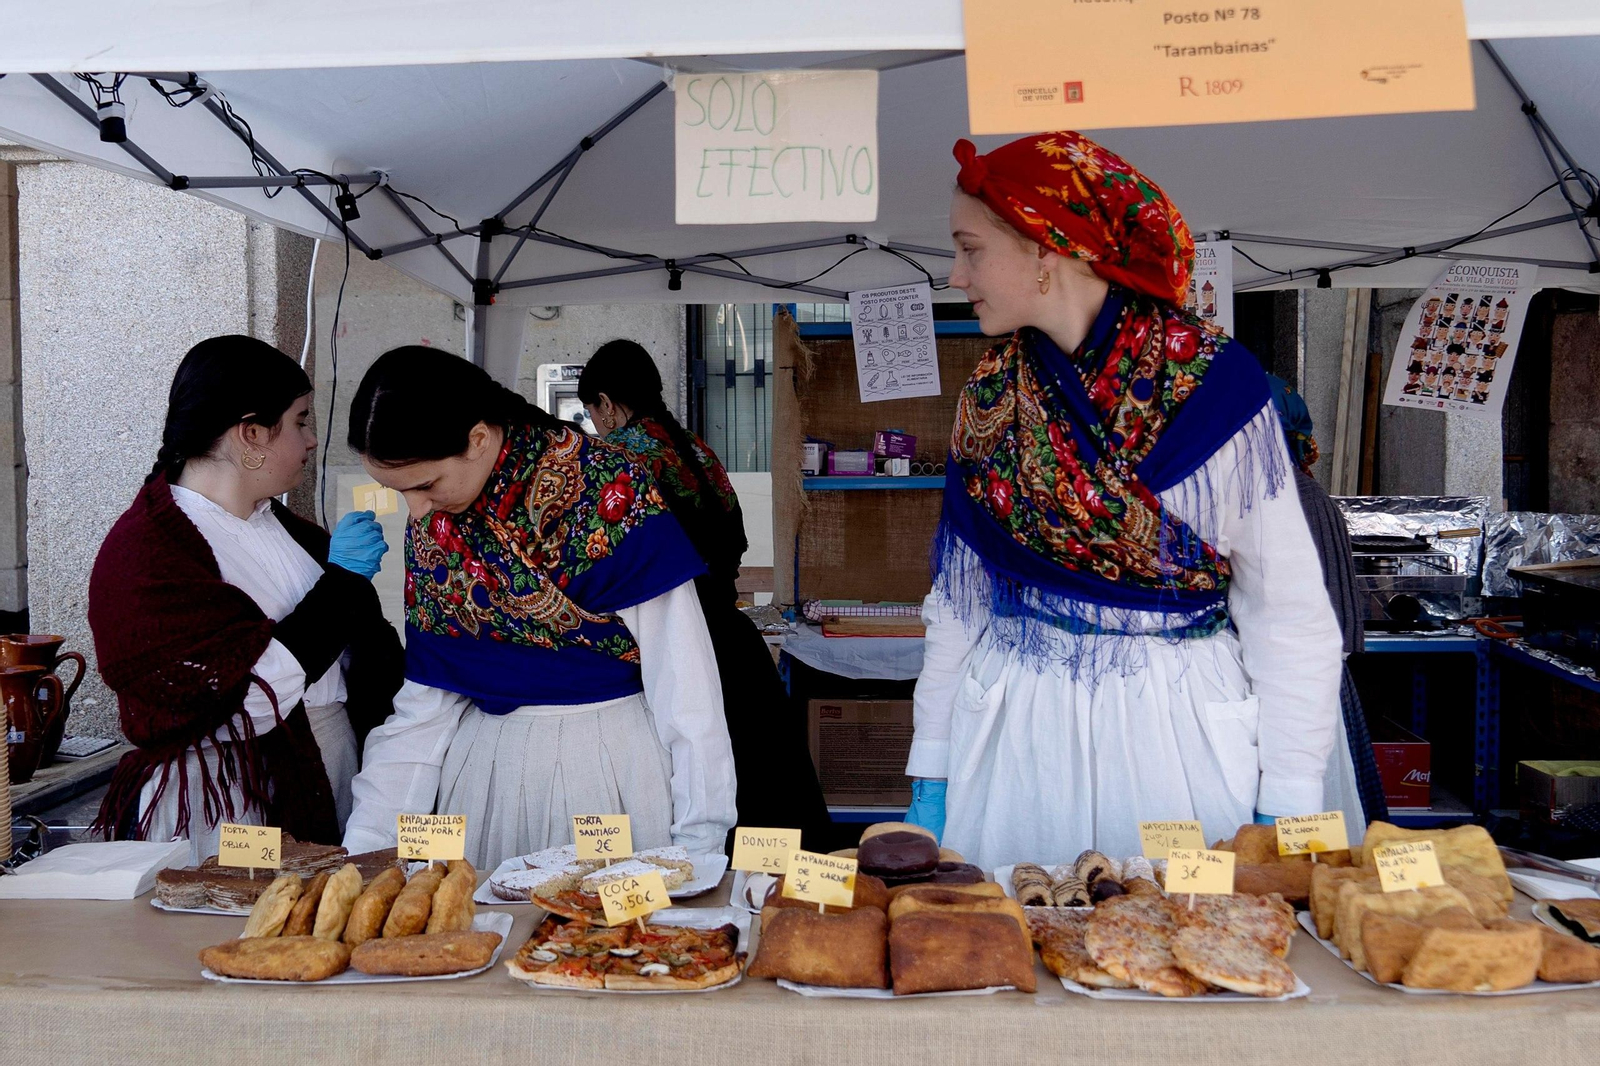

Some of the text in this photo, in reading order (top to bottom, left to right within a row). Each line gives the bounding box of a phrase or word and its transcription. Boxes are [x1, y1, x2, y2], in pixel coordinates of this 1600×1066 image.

[1163, 8, 1261, 25] Posto Nº 78
[1153, 38, 1276, 58] "Tarambainas"
[1017, 86, 1058, 95] CONCELLO
[1179, 76, 1244, 97] R 1809
[684, 75, 777, 136] SOLO
[696, 145, 874, 200] EFECTIVO
[1448, 265, 1519, 279] ECONQUISTA
[1466, 276, 1483, 284] VILA
[1485, 277, 1495, 285] DE
[1497, 278, 1515, 286] VIGO
[870, 290, 898, 298] PRODUTOS
[574, 816, 603, 825] TORTA
[222, 826, 248, 835] TORTA
[431, 826, 454, 836] YORK
[579, 826, 620, 837] SANTIAGO
[1281, 827, 1292, 836] DE
[222, 840, 250, 849] OBLEA
[594, 838, 613, 853] 2€
[742, 835, 788, 848] DONUTS
[261, 847, 276, 861] 2€
[798, 867, 849, 883] DE CARNE
[1181, 865, 1200, 880] 3€
[603, 879, 639, 897] COCA
